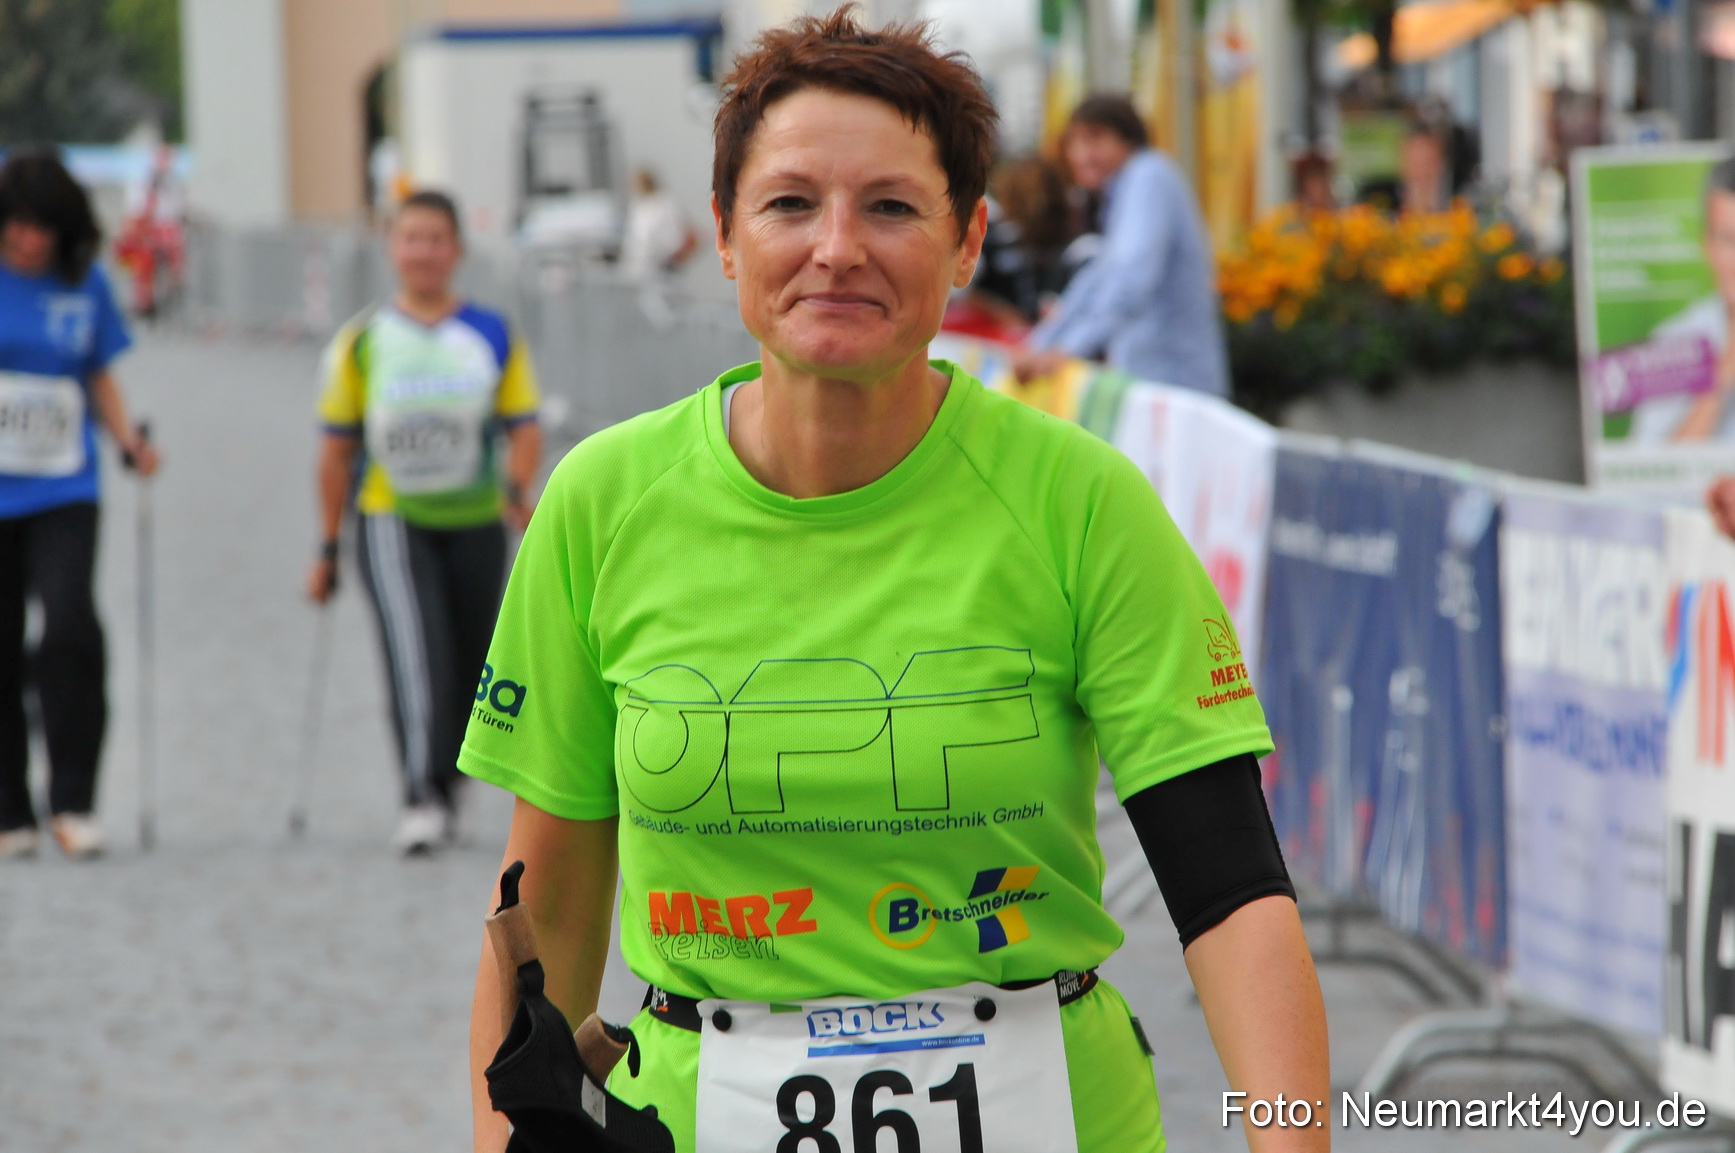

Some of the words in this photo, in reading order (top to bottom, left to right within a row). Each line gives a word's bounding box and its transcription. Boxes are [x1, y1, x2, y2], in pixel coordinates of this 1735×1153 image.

[478, 708, 514, 734] Türen
[695, 819, 732, 835] und
[738, 811, 987, 836] Automatisierungstechnik
[993, 801, 1044, 825] GmbH
[648, 887, 818, 939] MERZ
[889, 889, 1050, 934] Bretschneider
[648, 919, 780, 961] Reisen
[1060, 978, 1081, 999] MOVE
[806, 1002, 945, 1038] BOCK
[776, 1062, 984, 1153] 861
